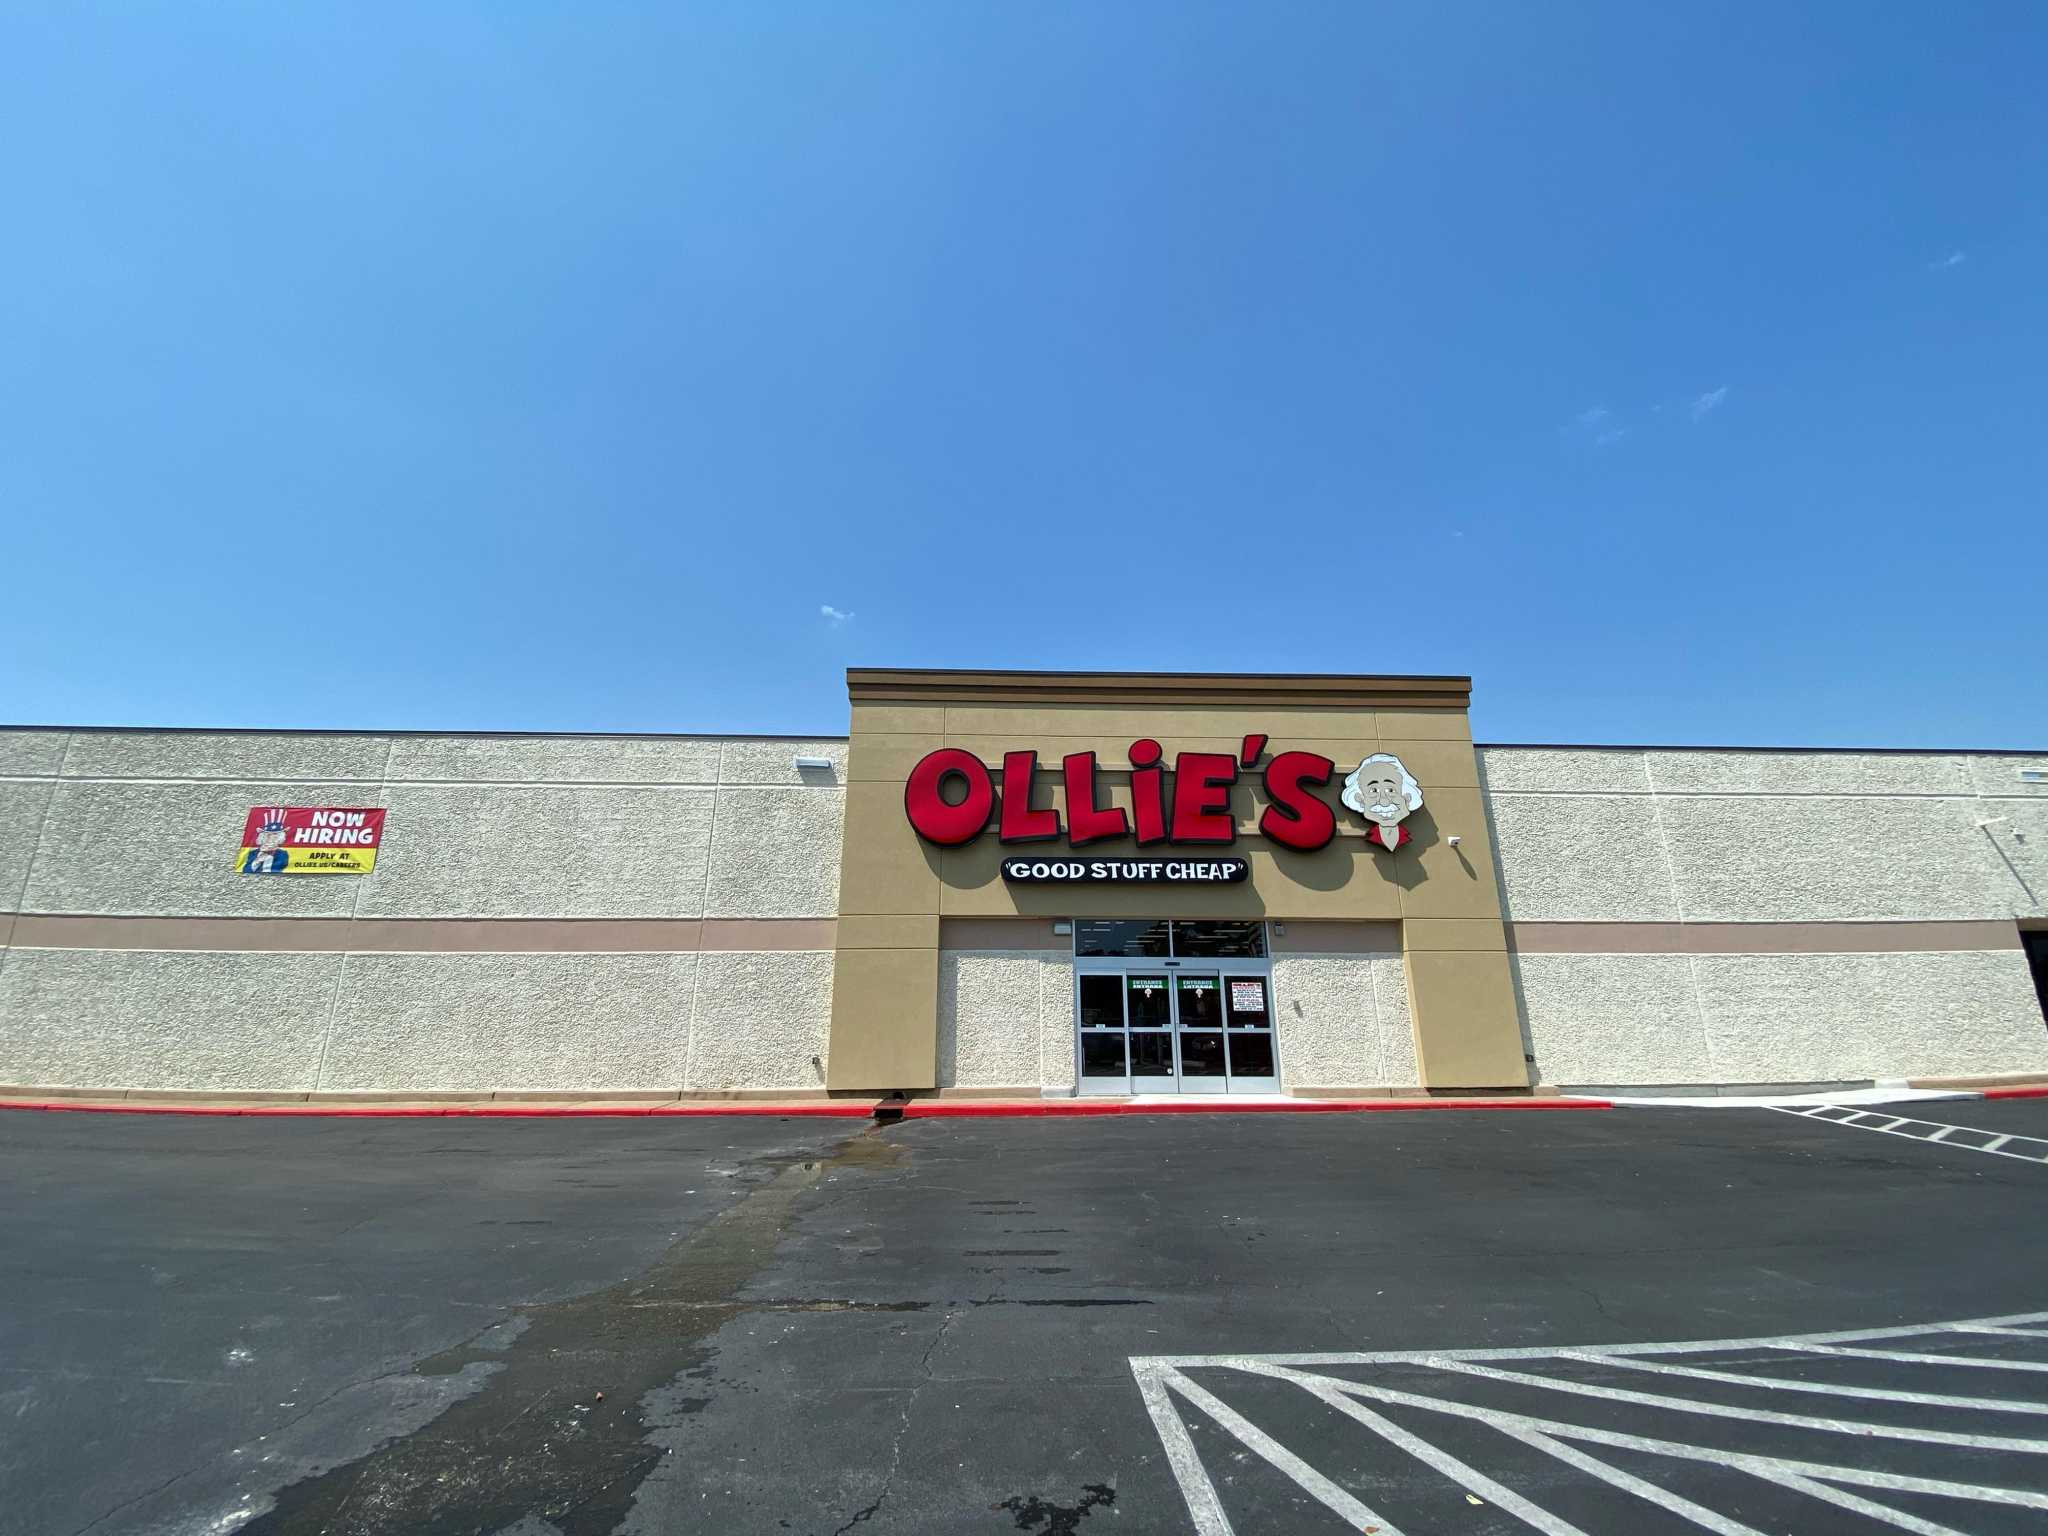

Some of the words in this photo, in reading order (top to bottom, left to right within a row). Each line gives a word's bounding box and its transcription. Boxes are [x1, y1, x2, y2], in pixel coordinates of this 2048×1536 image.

[311, 811, 366, 827] NOW
[293, 828, 374, 844] HIRING
[1091, 862, 1163, 879] STUFF
